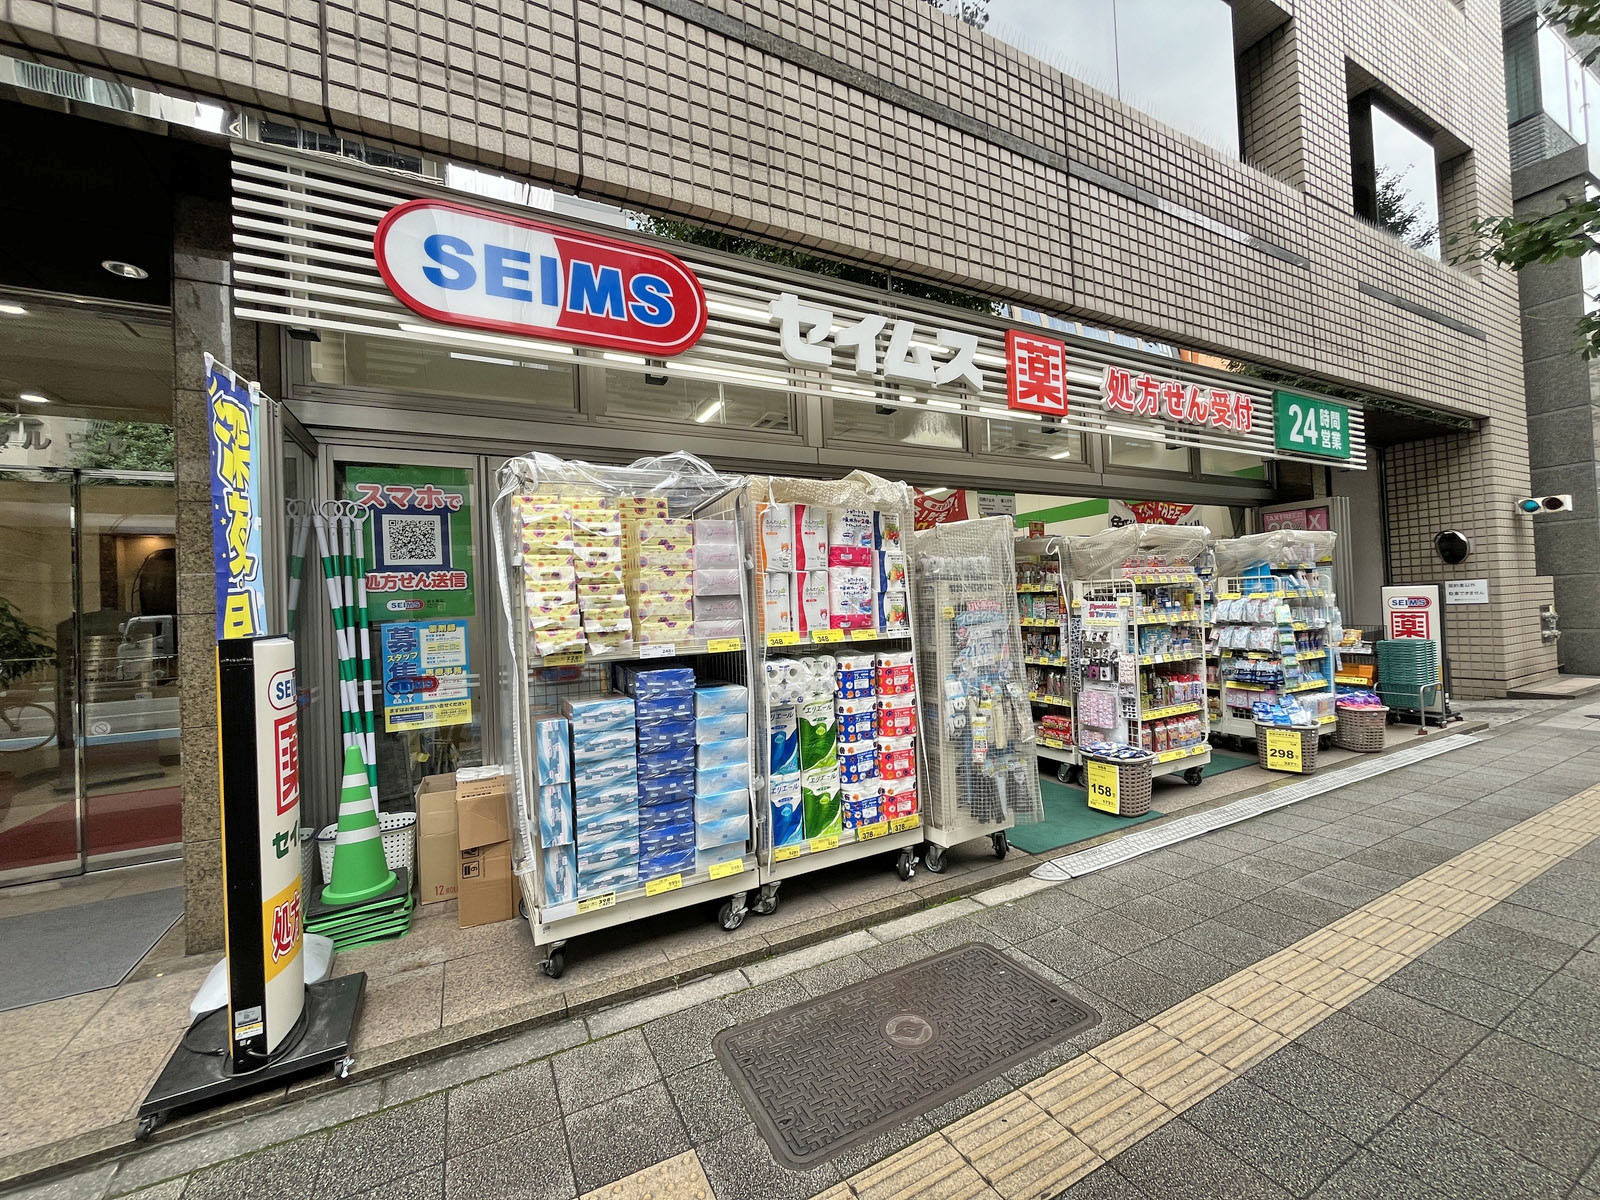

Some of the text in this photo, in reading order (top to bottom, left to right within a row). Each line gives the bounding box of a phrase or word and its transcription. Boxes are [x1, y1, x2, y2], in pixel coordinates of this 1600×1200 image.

[422, 233, 676, 328] SEIMS
[769, 292, 984, 393] セイムス
[1015, 339, 1062, 406] 薬
[1105, 364, 1254, 433] 処方せん受付
[1288, 404, 1342, 445] 24 時間
[1320, 429, 1342, 451] 営業
[356, 483, 464, 511] スマホで
[1158, 502, 1183, 519] FREE
[391, 602, 421, 610] SEIMS
[1394, 614, 1426, 638] 薬
[816, 635, 829, 643] 348
[387, 651, 418, 663] スタッフ
[805, 704, 833, 714] エリエール
[1269, 748, 1294, 760] 298
[809, 772, 837, 784] エリエール
[1091, 783, 1112, 797] 158
[862, 830, 873, 839] 378
[894, 823, 905, 832] 378
